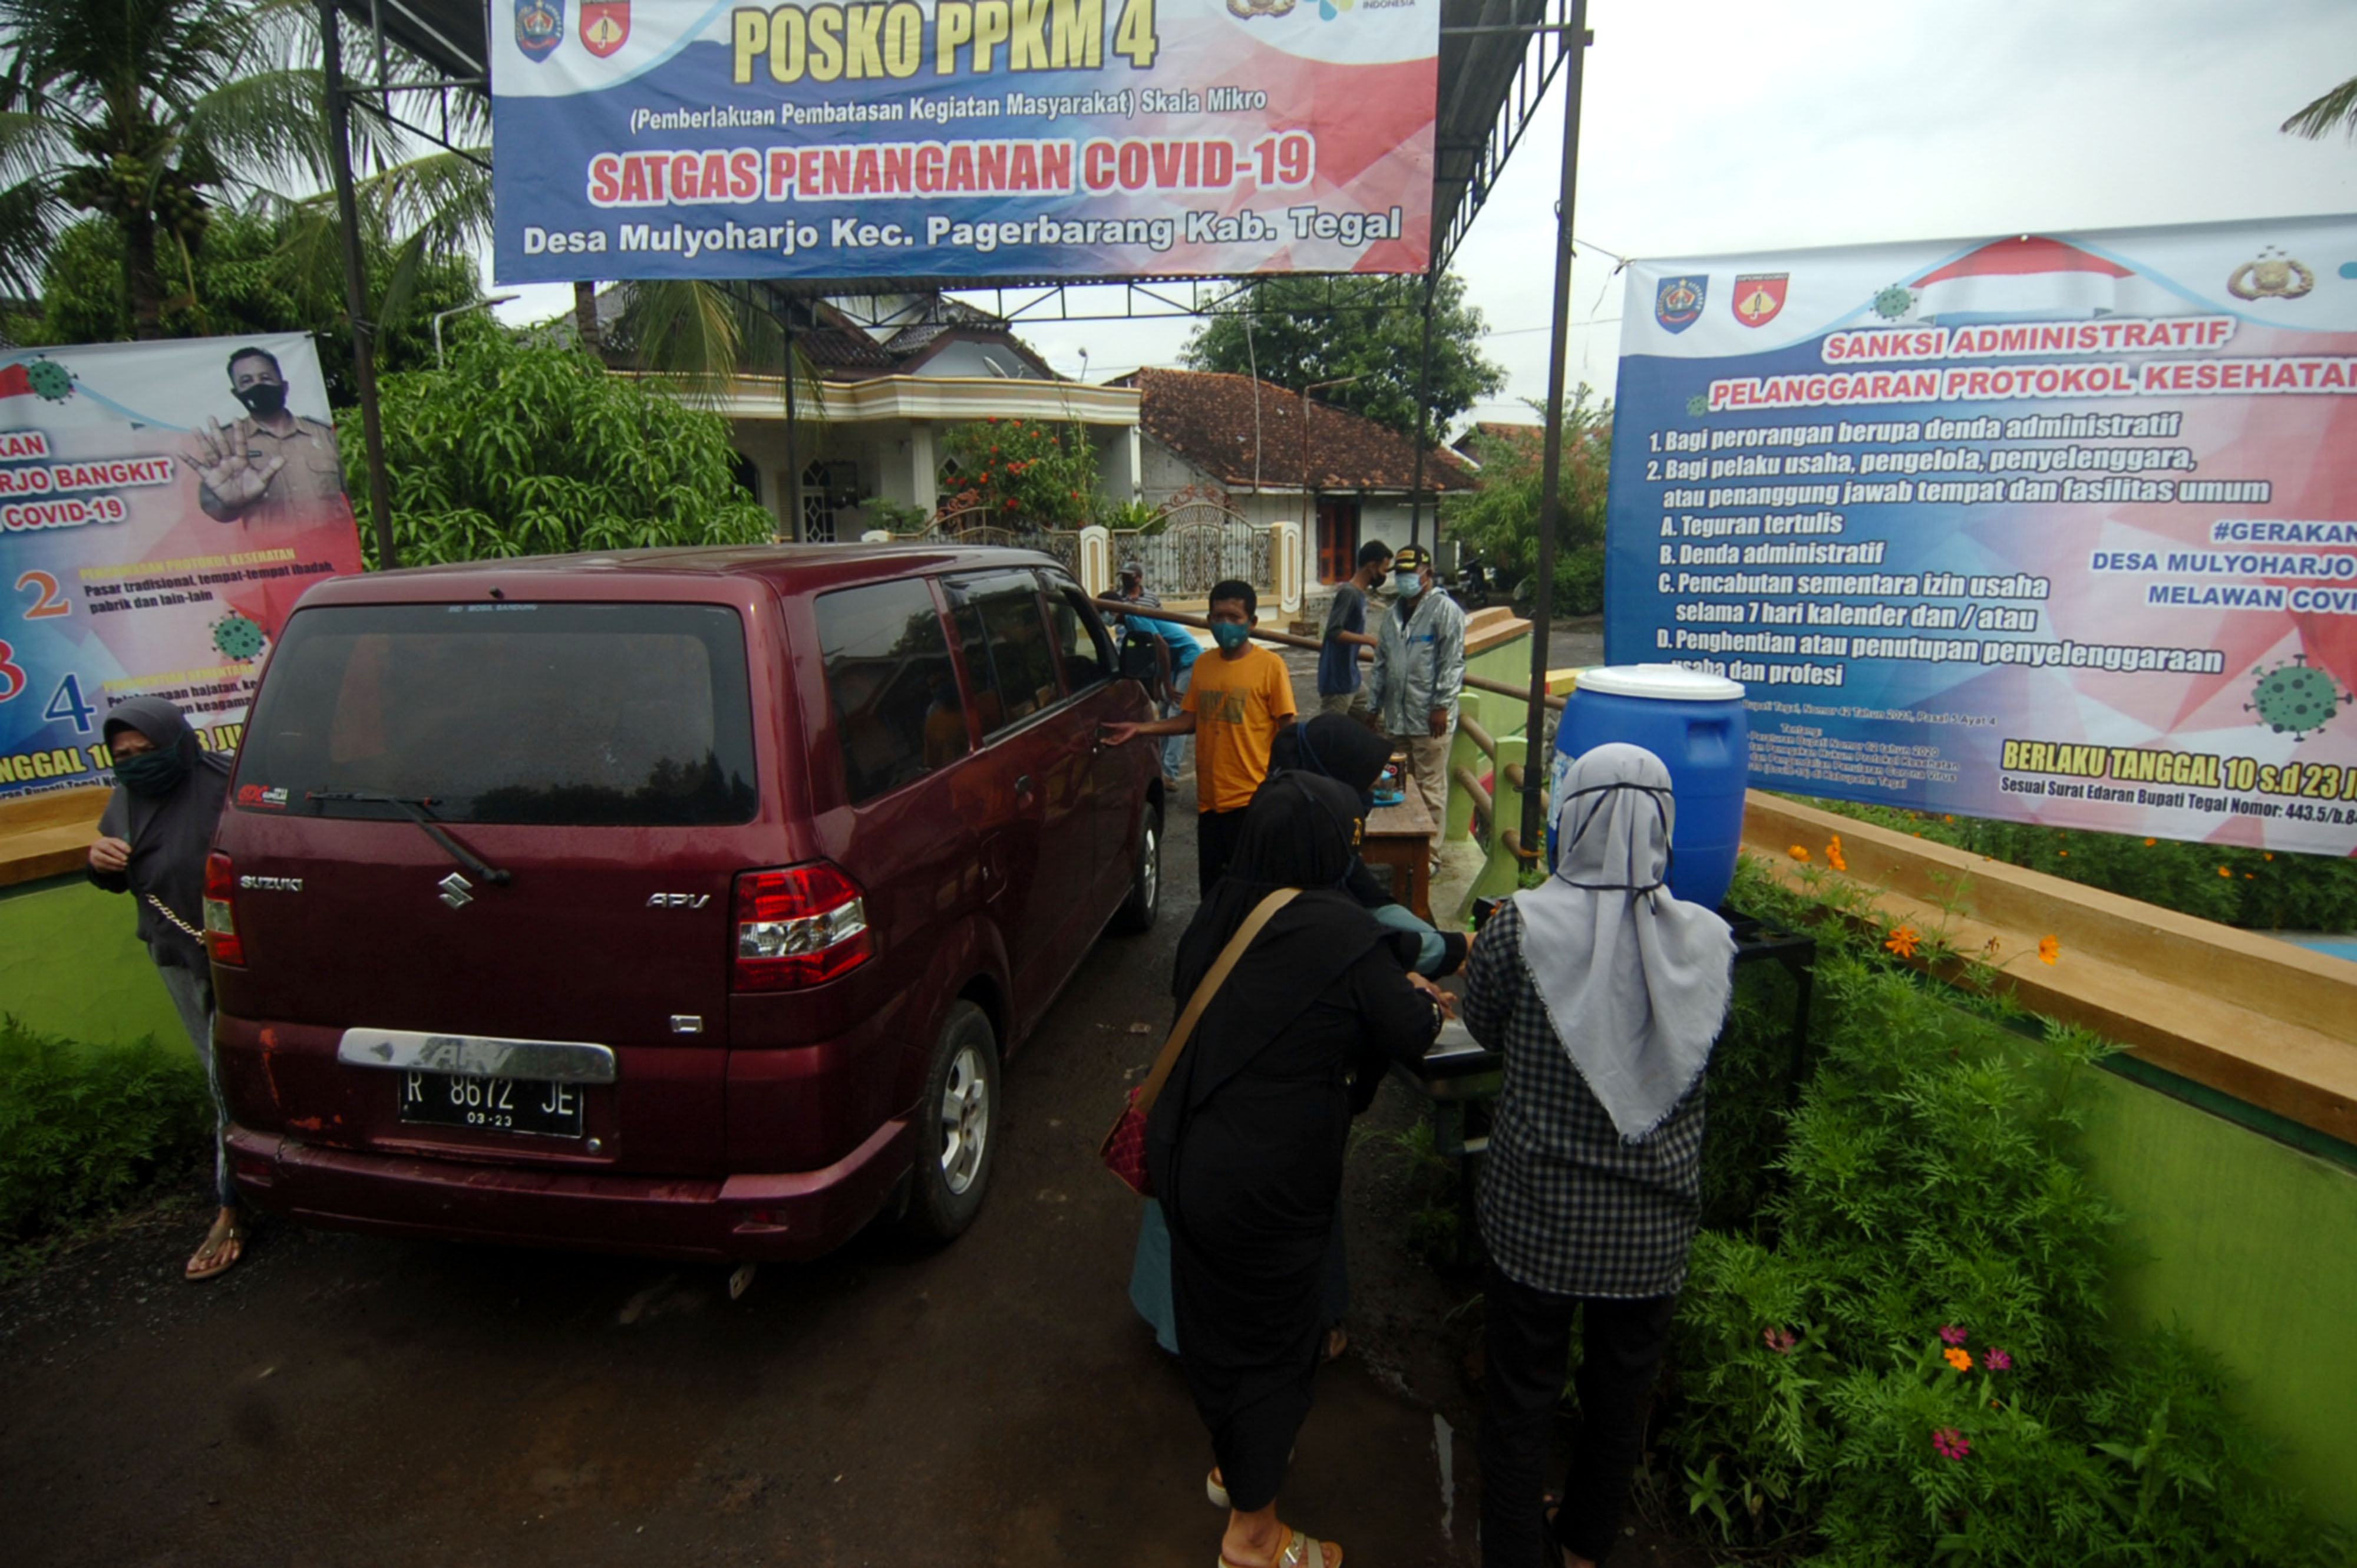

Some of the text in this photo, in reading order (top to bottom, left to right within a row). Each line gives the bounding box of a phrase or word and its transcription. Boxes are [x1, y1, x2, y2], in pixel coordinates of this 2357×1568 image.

[734, 0, 1157, 84] POSKO PPKM 4
[631, 88, 1266, 133] (Pemberlakuan Pembatasan Kegiatan Masyarakat) Skala Mikro
[592, 136, 1311, 202] SATGAS PENANGANAN COVID-19
[524, 207, 1401, 258] Desa Mulyoharjo Kec. Pagerbarang Kab. Tegal
[1827, 321, 2229, 359] SANKSI ADMINISTRATIF
[1713, 374, 1936, 406] PELANGGARAN
[1947, 369, 2131, 395] PROTOKOL
[1650, 413, 2181, 454] 1. Bagi perorangan berupa denda administratif
[56, 461, 169, 487] BANGKIT
[1647, 447, 2196, 483] 2. Bagi pelaku usaha, pengelola, penyelenggara,
[1663, 478, 2270, 508] atau penanggung jawab tempat dan fasilitas umum
[5, 499, 122, 527] COVID-19
[1661, 512, 1843, 539] A. Teguran tertulis
[166, 554, 229, 573] PROTOKOL
[232, 547, 295, 566] KESEHATAN
[1660, 542, 1886, 565] B. Denda administratif
[2092, 553, 2355, 576] DESA MULYOHARJO
[16, 572, 70, 619] 2
[84, 582, 121, 597] Pasar
[199, 566, 289, 586] tempat-tempat
[1659, 573, 2049, 599] C. Pencabutan sementara izin usaha
[2148, 585, 2283, 608] MELAWAN
[90, 591, 212, 615] pabrik dan lain-lain
[1676, 602, 1744, 623] selama
[1749, 603, 1760, 621] 7
[1762, 603, 1803, 625] hari
[1807, 603, 1907, 628] kalender
[1912, 605, 1957, 629] dan
[1979, 609, 2036, 631] atau
[1657, 629, 2223, 673] D. Penghentian atau penutupan penyelenggaraan
[1730, 660, 1765, 681] dan
[1770, 663, 1843, 686] profesi
[45, 674, 95, 732] 4
[1853, 707, 1884, 718] Tahun
[1918, 711, 1948, 724] Pasal
[1960, 715, 1986, 726] Ayat
[1989, 717, 1997, 725] 4
[2003, 741, 2106, 777] BERLAKU
[2111, 750, 2219, 787] TANGGAL
[2225, 758, 2256, 790] 10
[2260, 762, 2300, 794] s.d
[2303, 766, 2340, 798] 23
[2002, 777, 2045, 796] Sesuai
[2048, 781, 2083, 799] Surat
[2087, 783, 2134, 804] Edaran
[2138, 790, 2184, 808] Bupati
[2188, 794, 2227, 813] Tegal
[2231, 798, 2282, 817] Nomor:
[240, 875, 303, 892] SUZUKI
[646, 893, 710, 908] APV
[408, 1072, 574, 1115] R 8672 JE
